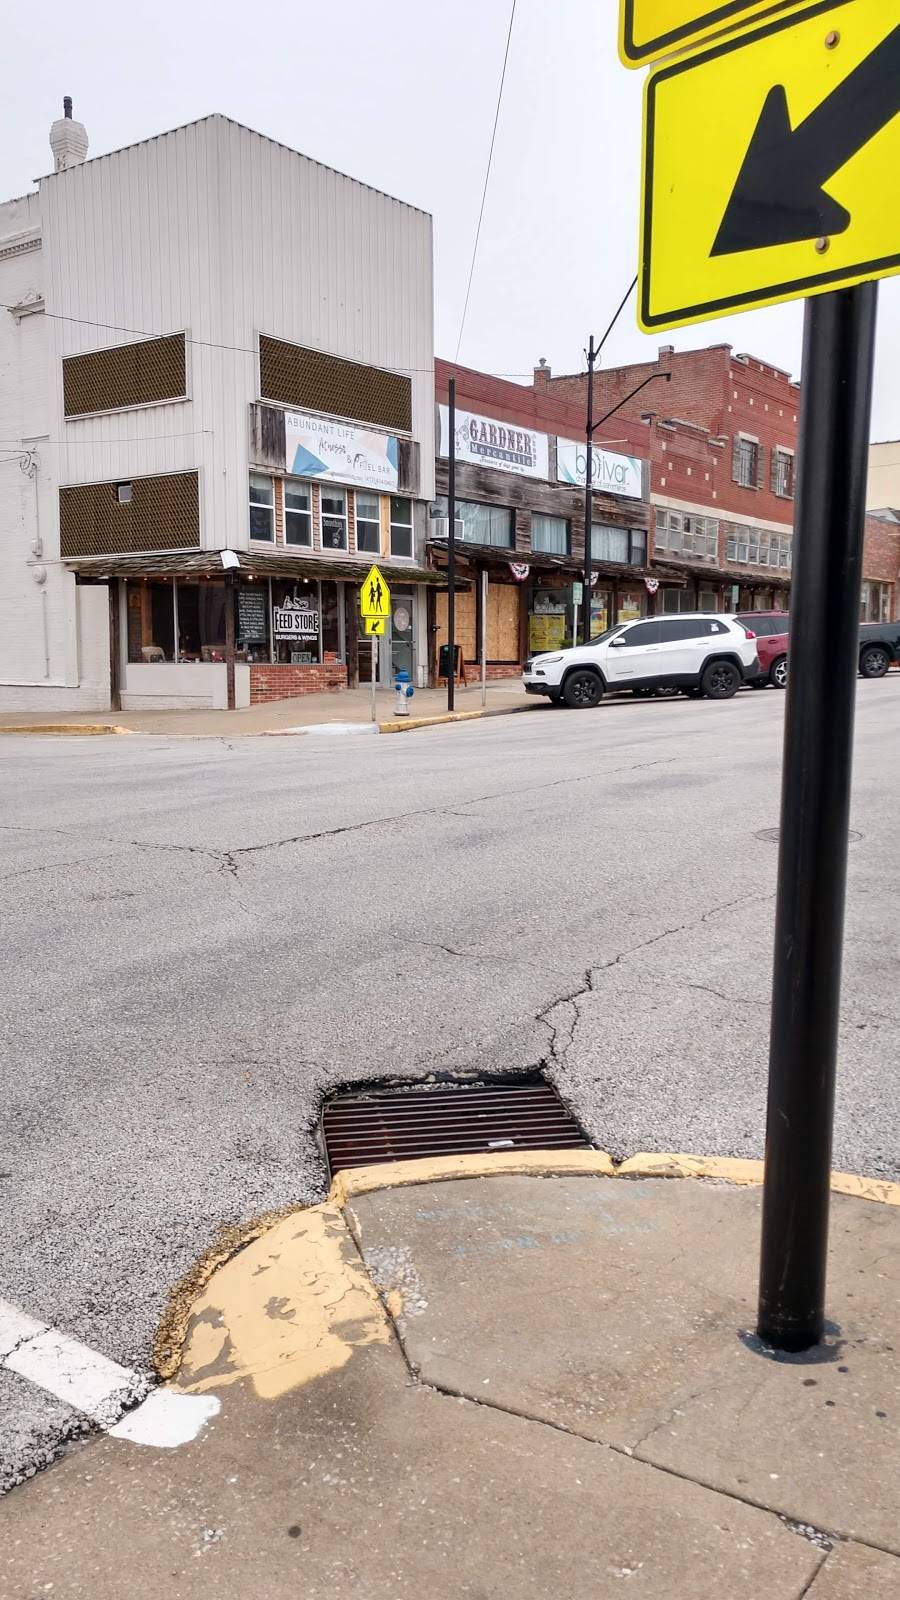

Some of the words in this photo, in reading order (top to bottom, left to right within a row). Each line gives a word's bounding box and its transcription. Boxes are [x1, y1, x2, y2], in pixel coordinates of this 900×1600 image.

[287, 417, 334, 435] ABUNDANT
[337, 428, 355, 440] LIFE
[469, 419, 532, 456] GARDNER
[471, 443, 532, 466] Mercantile
[275, 611, 293, 632] FEED
[294, 613, 318, 632] STORE
[292, 653, 311, 663] OPEN
